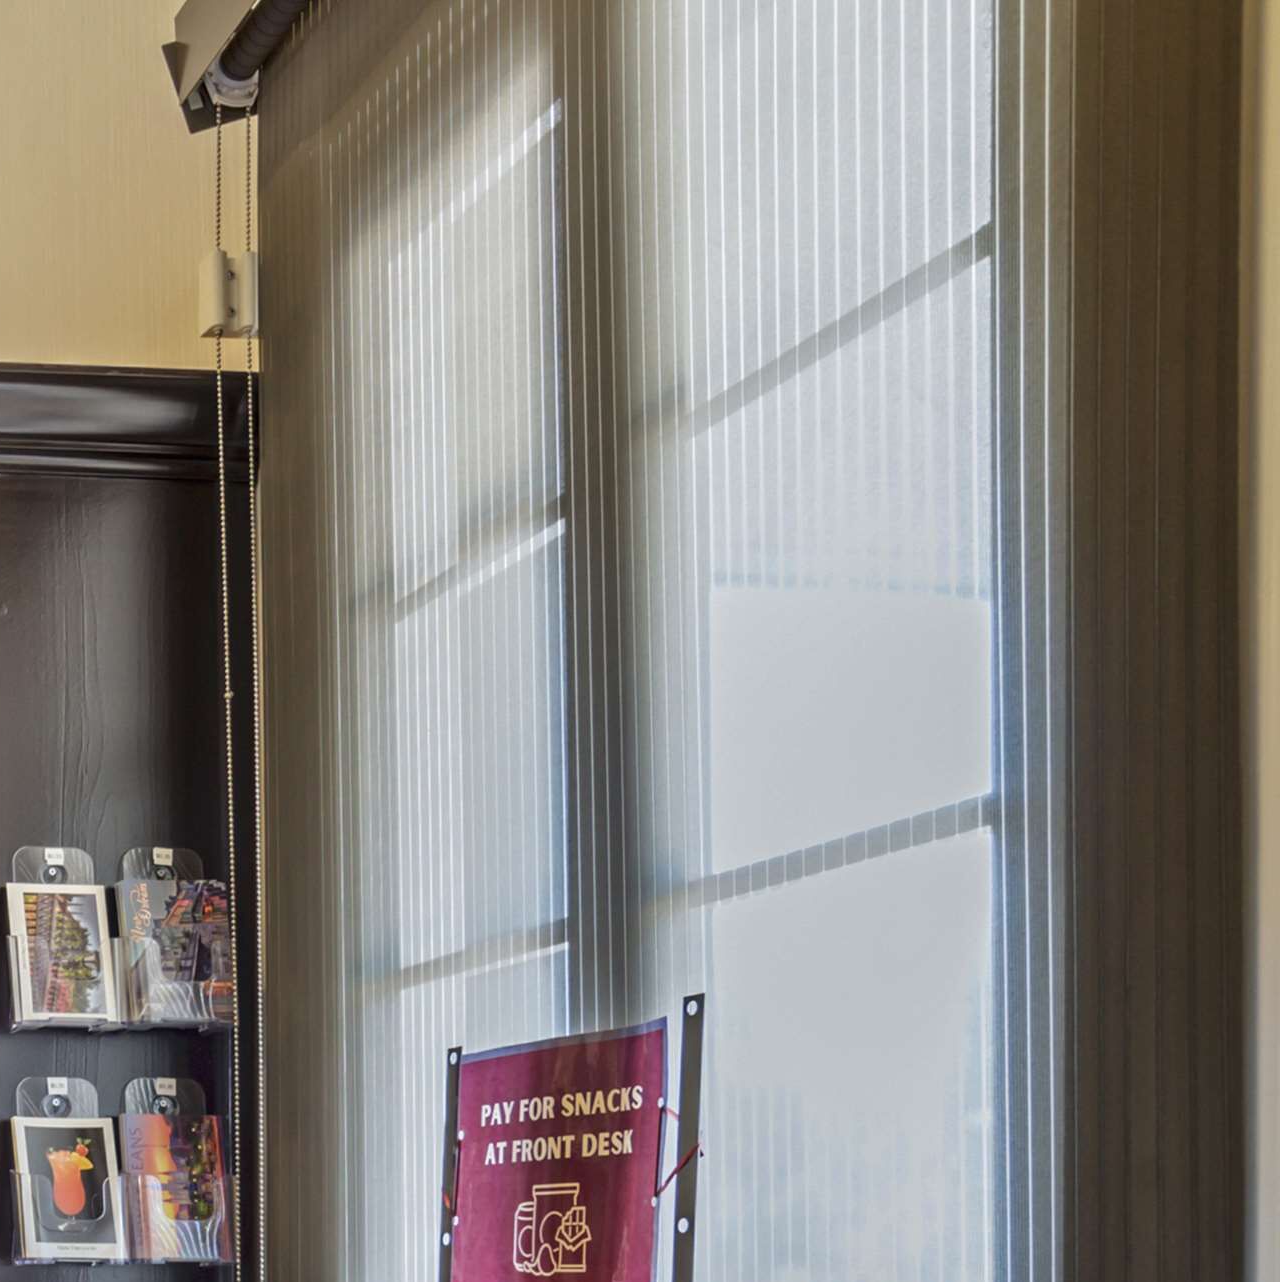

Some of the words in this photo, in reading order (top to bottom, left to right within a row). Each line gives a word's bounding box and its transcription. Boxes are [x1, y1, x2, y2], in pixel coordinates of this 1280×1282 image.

[481, 1100, 514, 1127] PAY
[518, 1095, 555, 1123] FOR
[560, 1084, 644, 1118] SNACKS
[484, 1141, 508, 1166] AT
[511, 1134, 576, 1164] FRONT
[581, 1128, 634, 1158] DESK
